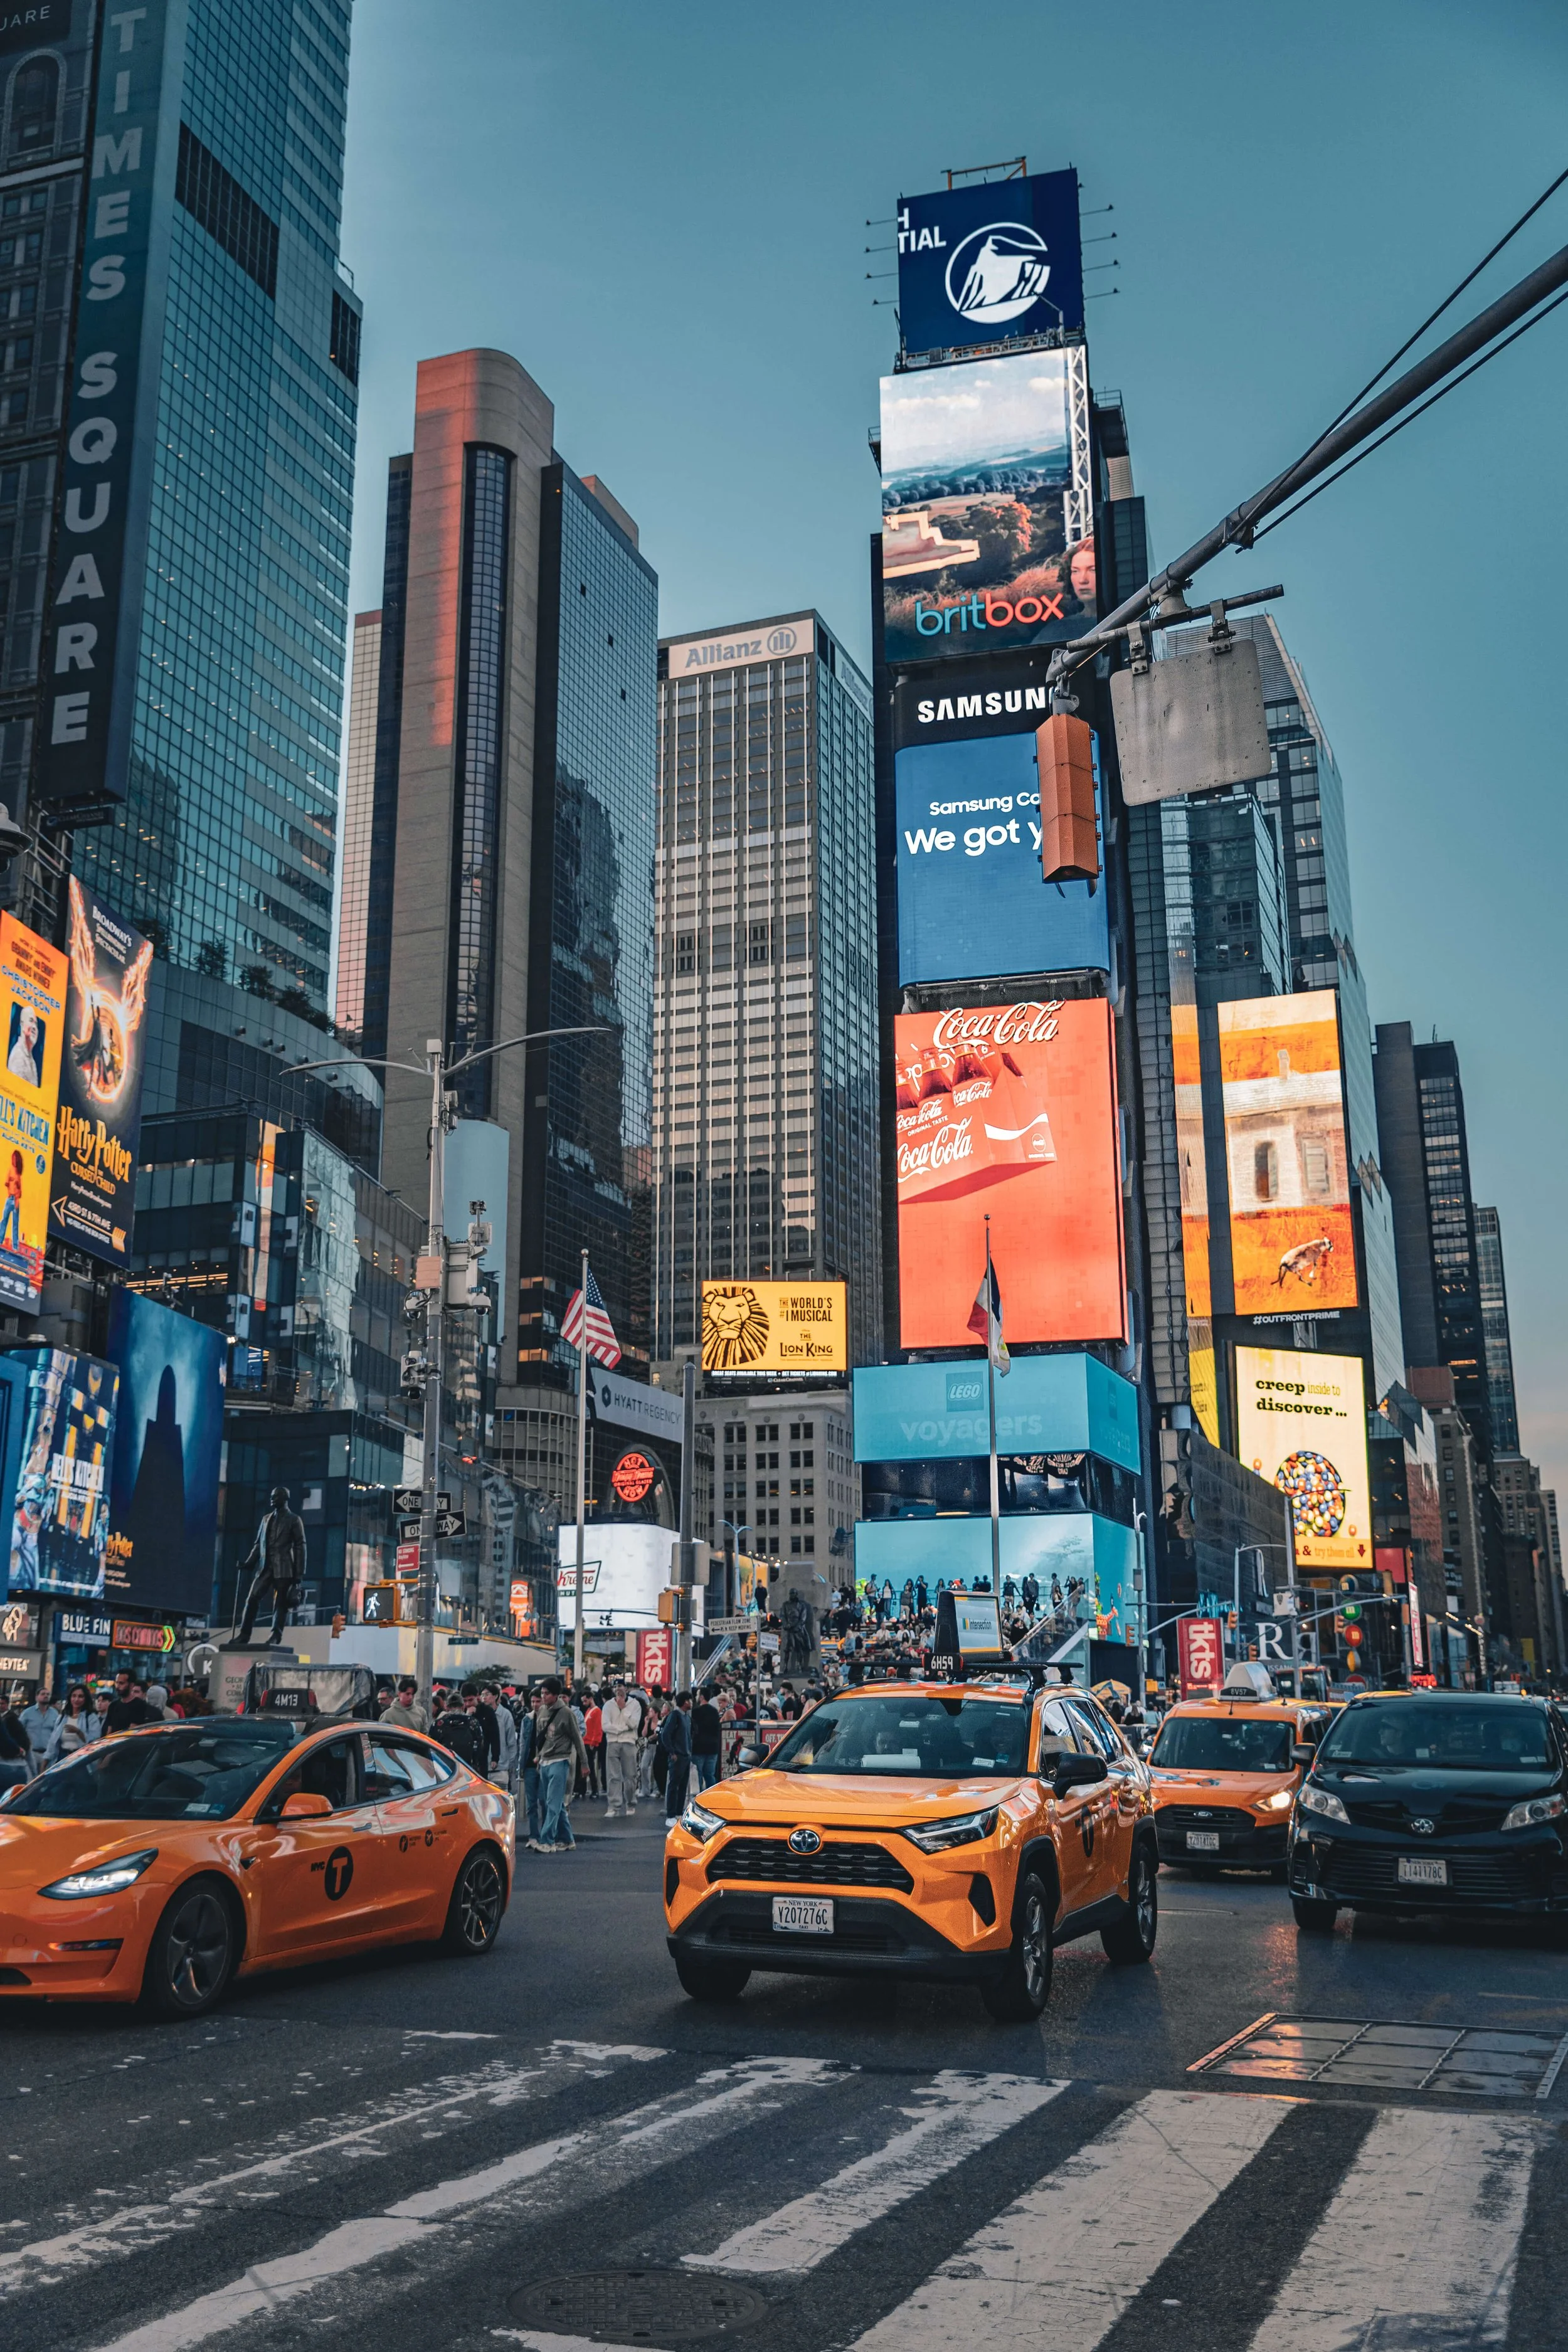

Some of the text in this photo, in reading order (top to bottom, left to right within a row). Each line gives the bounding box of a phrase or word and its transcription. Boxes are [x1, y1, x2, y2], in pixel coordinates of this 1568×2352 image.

[898, 226, 946, 253] TIAL
[51, 8, 146, 744] TIMES SQUARE
[916, 593, 1064, 636] britbox
[685, 640, 762, 667] Allianz
[918, 687, 1054, 723] SAMSUN
[930, 795, 1013, 815] Samsung
[904, 828, 956, 854] We
[963, 818, 1020, 856] got
[1, 965, 61, 1011] CHRISTOPHER
[11, 985, 50, 1015] JACKSON
[907, 1115, 948, 1136] ORIGINAL TASTE
[57, 1106, 96, 1164] Harry
[95, 1120, 132, 1182] Potter
[70, 1161, 95, 1184] CURSED
[96, 1175, 115, 1195] CHILD
[791, 1297, 832, 1308] WORLD'S
[791, 1310, 833, 1322] MUSICAL
[1253, 1311, 1340, 1325] #OUTFRONTPRIME
[949, 1382, 981, 1399] LEGO
[1256, 1380, 1340, 1396] creep inside to
[614, 1393, 681, 1425] HYATT REGENCY
[403, 1496, 418, 1507] ONE
[410, 1520, 455, 1535] ON WAY
[1302, 1545, 1311, 1556] &
[93, 1618, 111, 1635] FIN
[969, 1618, 992, 1630] Intersection
[1189, 1621, 1216, 1679] tkts
[1255, 1623, 1294, 1660] R
[644, 1631, 668, 1683] tkts
[931, 1655, 953, 1670] 6H59
[275, 1694, 299, 1707] 4M13
[310, 1861, 325, 1872] NYC
[332, 1857, 348, 1894] T
[778, 1907, 827, 1925] Y207276C
